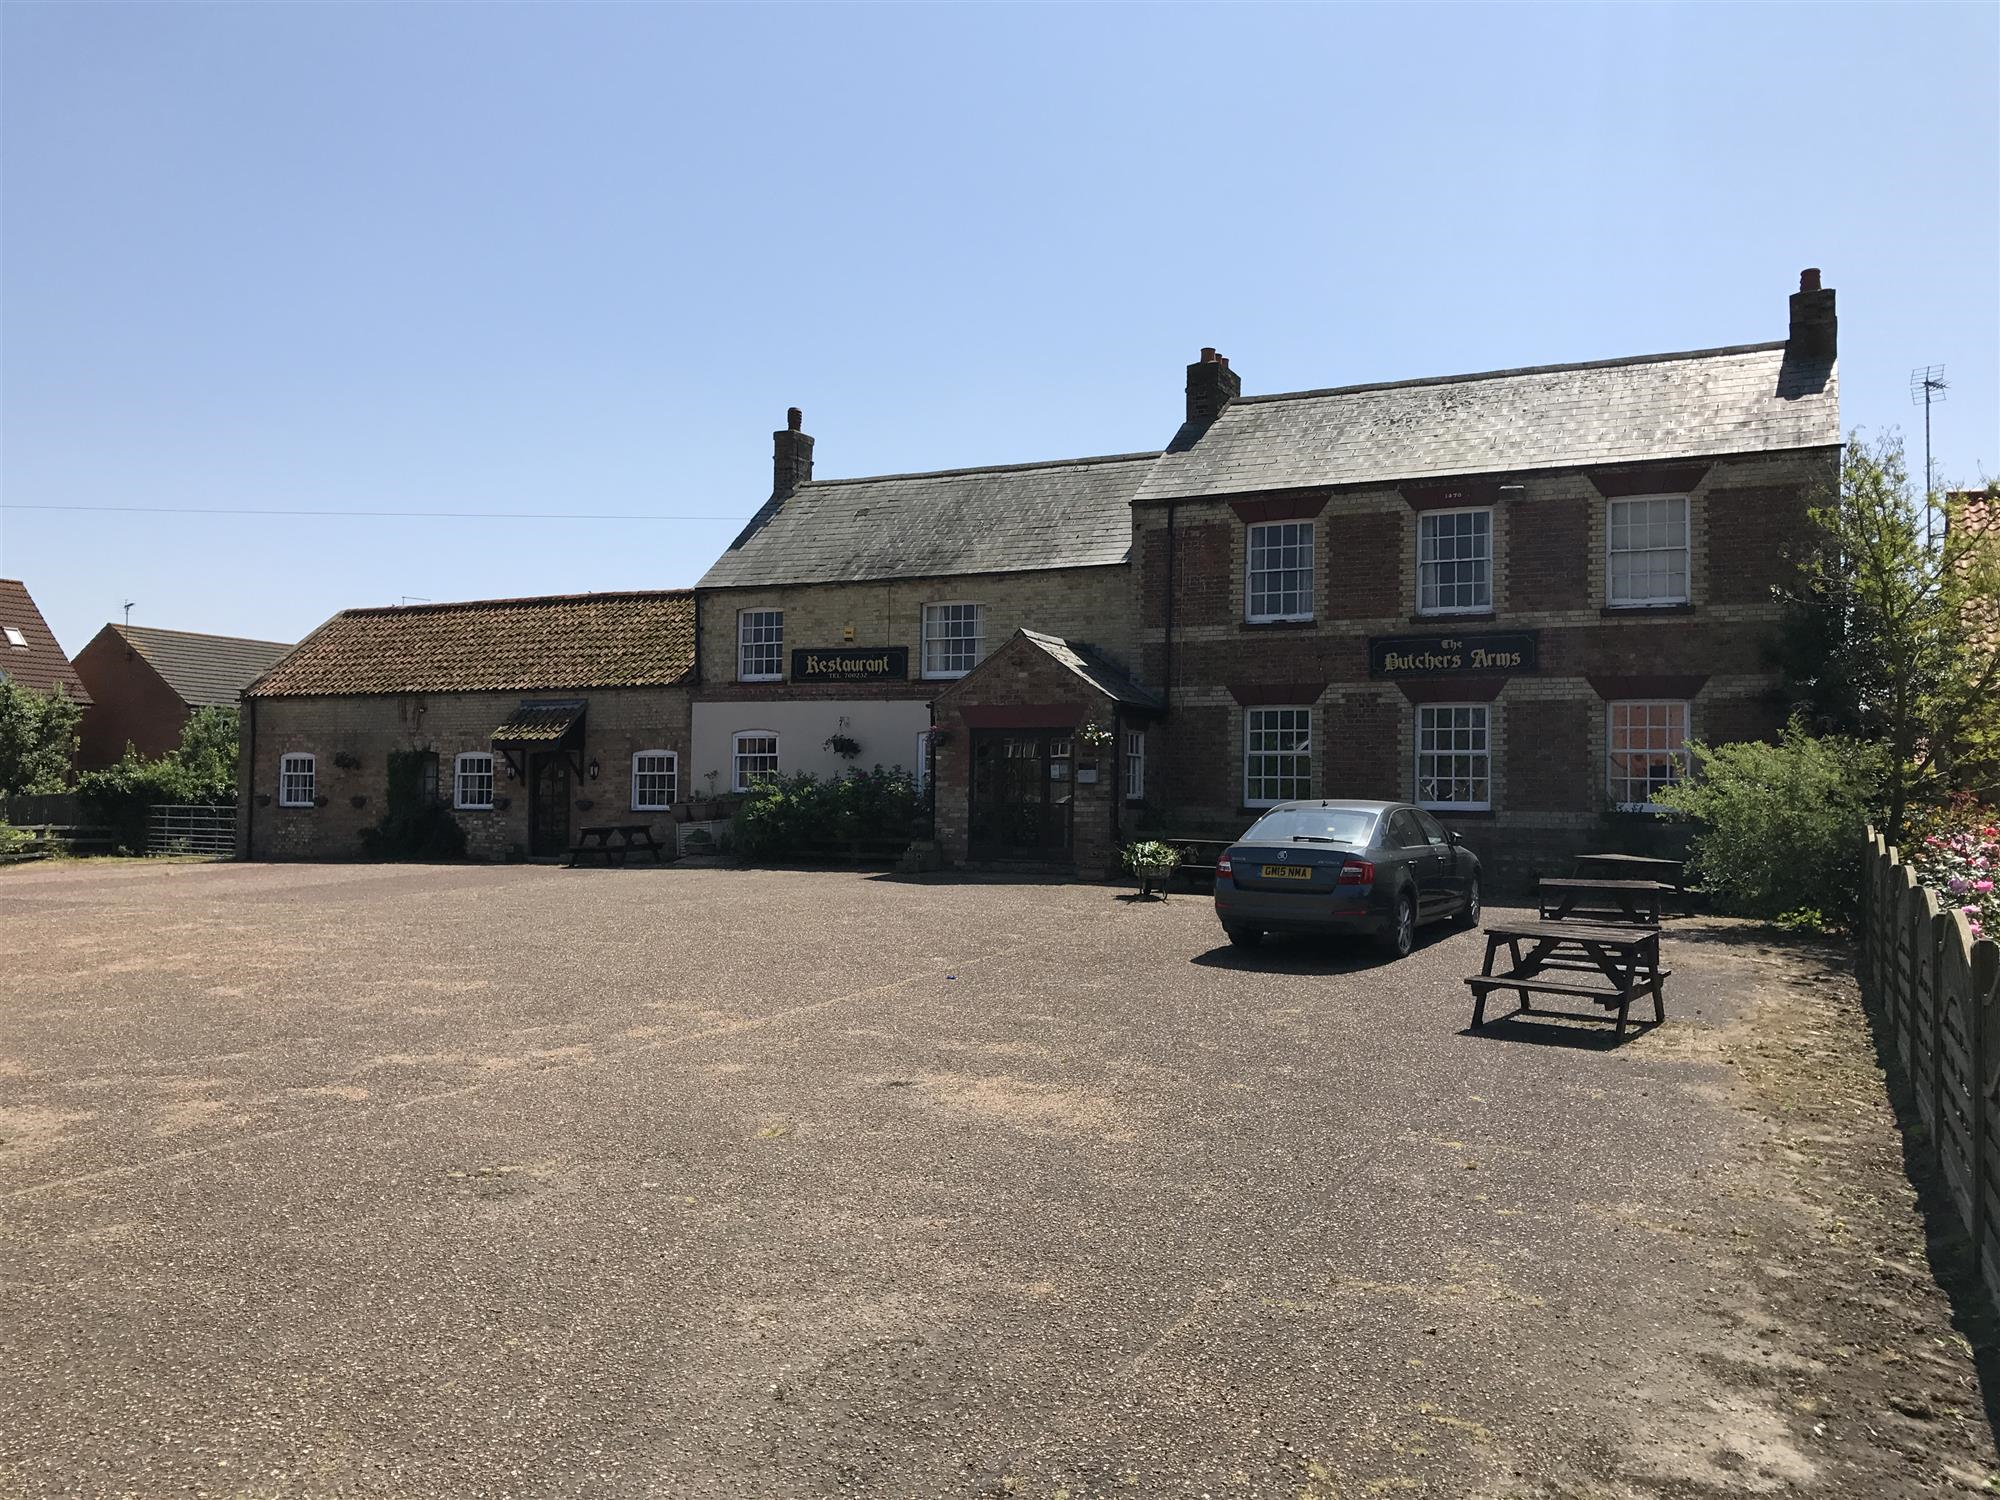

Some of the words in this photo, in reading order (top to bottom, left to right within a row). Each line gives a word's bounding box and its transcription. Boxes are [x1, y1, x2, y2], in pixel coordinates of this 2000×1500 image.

[1440, 639, 1463, 650] The
[805, 655, 889, 674] Restaurant
[1384, 650, 1462, 672] Butchers
[1470, 648, 1521, 669] Arms
[1265, 866, 1286, 876] GM15
